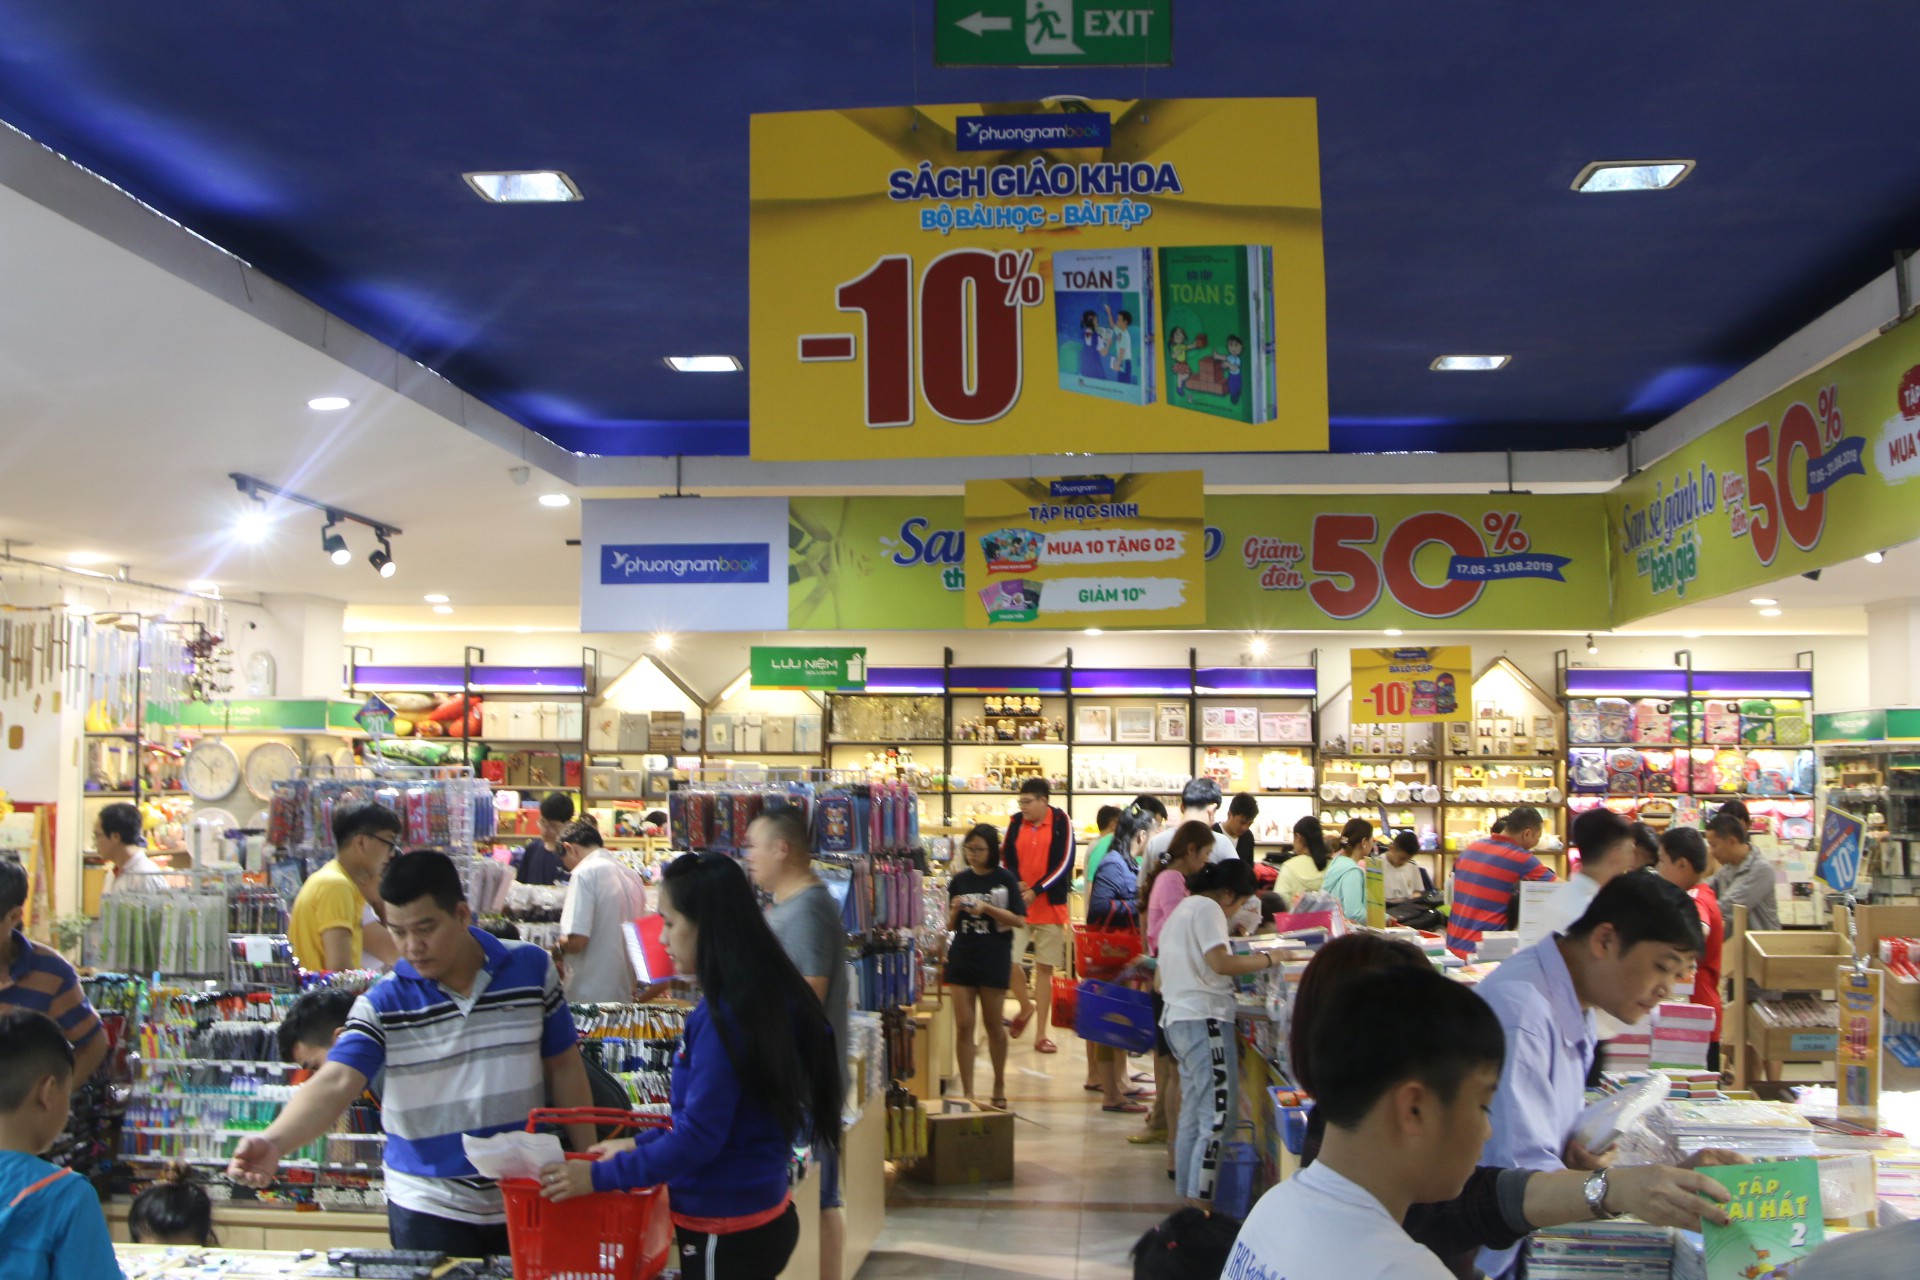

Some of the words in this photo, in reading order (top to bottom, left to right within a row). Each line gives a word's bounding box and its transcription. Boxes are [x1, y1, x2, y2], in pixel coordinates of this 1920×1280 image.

[1084, 10, 1154, 36] EXIT
[979, 123, 1100, 144] phuongnambook
[890, 161, 985, 200] SÁCH
[990, 158, 1077, 197] GIÁO
[1080, 163, 1182, 195] KHOA
[920, 204, 954, 234] BỘ
[955, 203, 996, 229] BÀI
[998, 205, 1045, 234] HỌC
[1063, 200, 1102, 226] BÀI
[1102, 199, 1151, 229] TẬP
[1062, 267, 1113, 289] TOÁN
[1115, 266, 1130, 289] 5
[1223, 284, 1236, 306] 5
[1888, 433, 1917, 466] MUA
[1701, 460, 1716, 517] lo
[1028, 503, 1060, 524] TẬP
[1063, 504, 1098, 523] HỌC
[1100, 503, 1138, 517] SINH
[1047, 541, 1083, 555] MUA
[1086, 540, 1104, 553] 10
[1107, 536, 1151, 556] TẶNG
[1154, 537, 1175, 551] 02
[1242, 535, 1304, 568] Giảm
[625, 555, 759, 577] phuongnambook
[1260, 562, 1304, 591] đến
[1456, 563, 1486, 575] 17.05
[1493, 561, 1554, 574] 31.08.2019
[1078, 584, 1118, 603] GIẢM
[1738, 1176, 1781, 1201] TẬP
[1760, 1190, 1809, 1221] HÁT
[1790, 1222, 1808, 1247] 2
